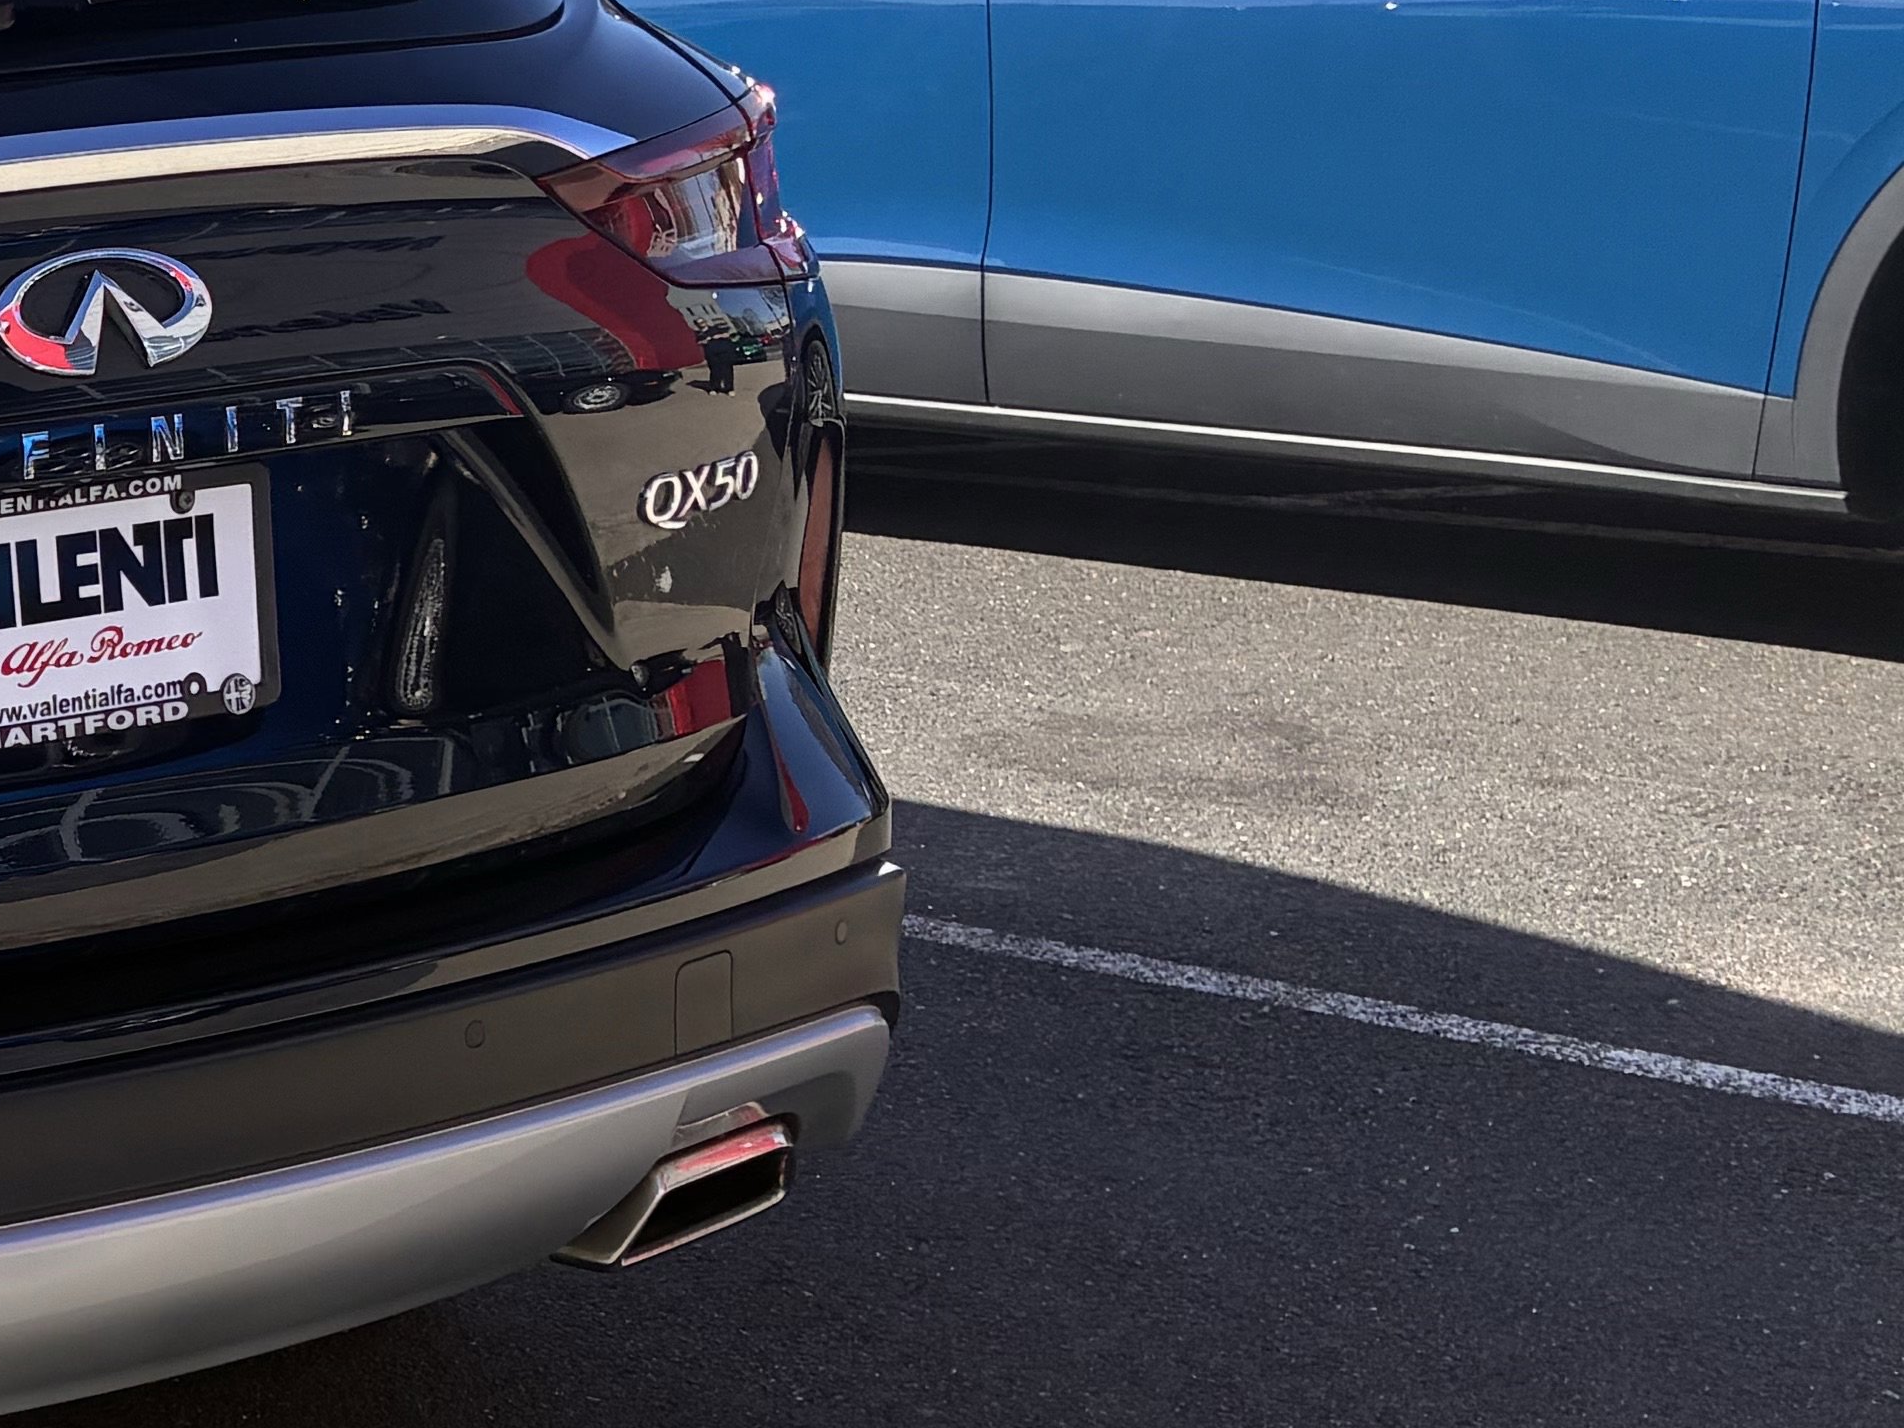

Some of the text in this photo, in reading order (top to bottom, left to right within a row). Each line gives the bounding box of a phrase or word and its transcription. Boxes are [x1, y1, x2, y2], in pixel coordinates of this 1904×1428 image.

[637, 450, 759, 530] QX50
[0, 637, 84, 688] Alfa
[86, 625, 204, 664] Romeo
